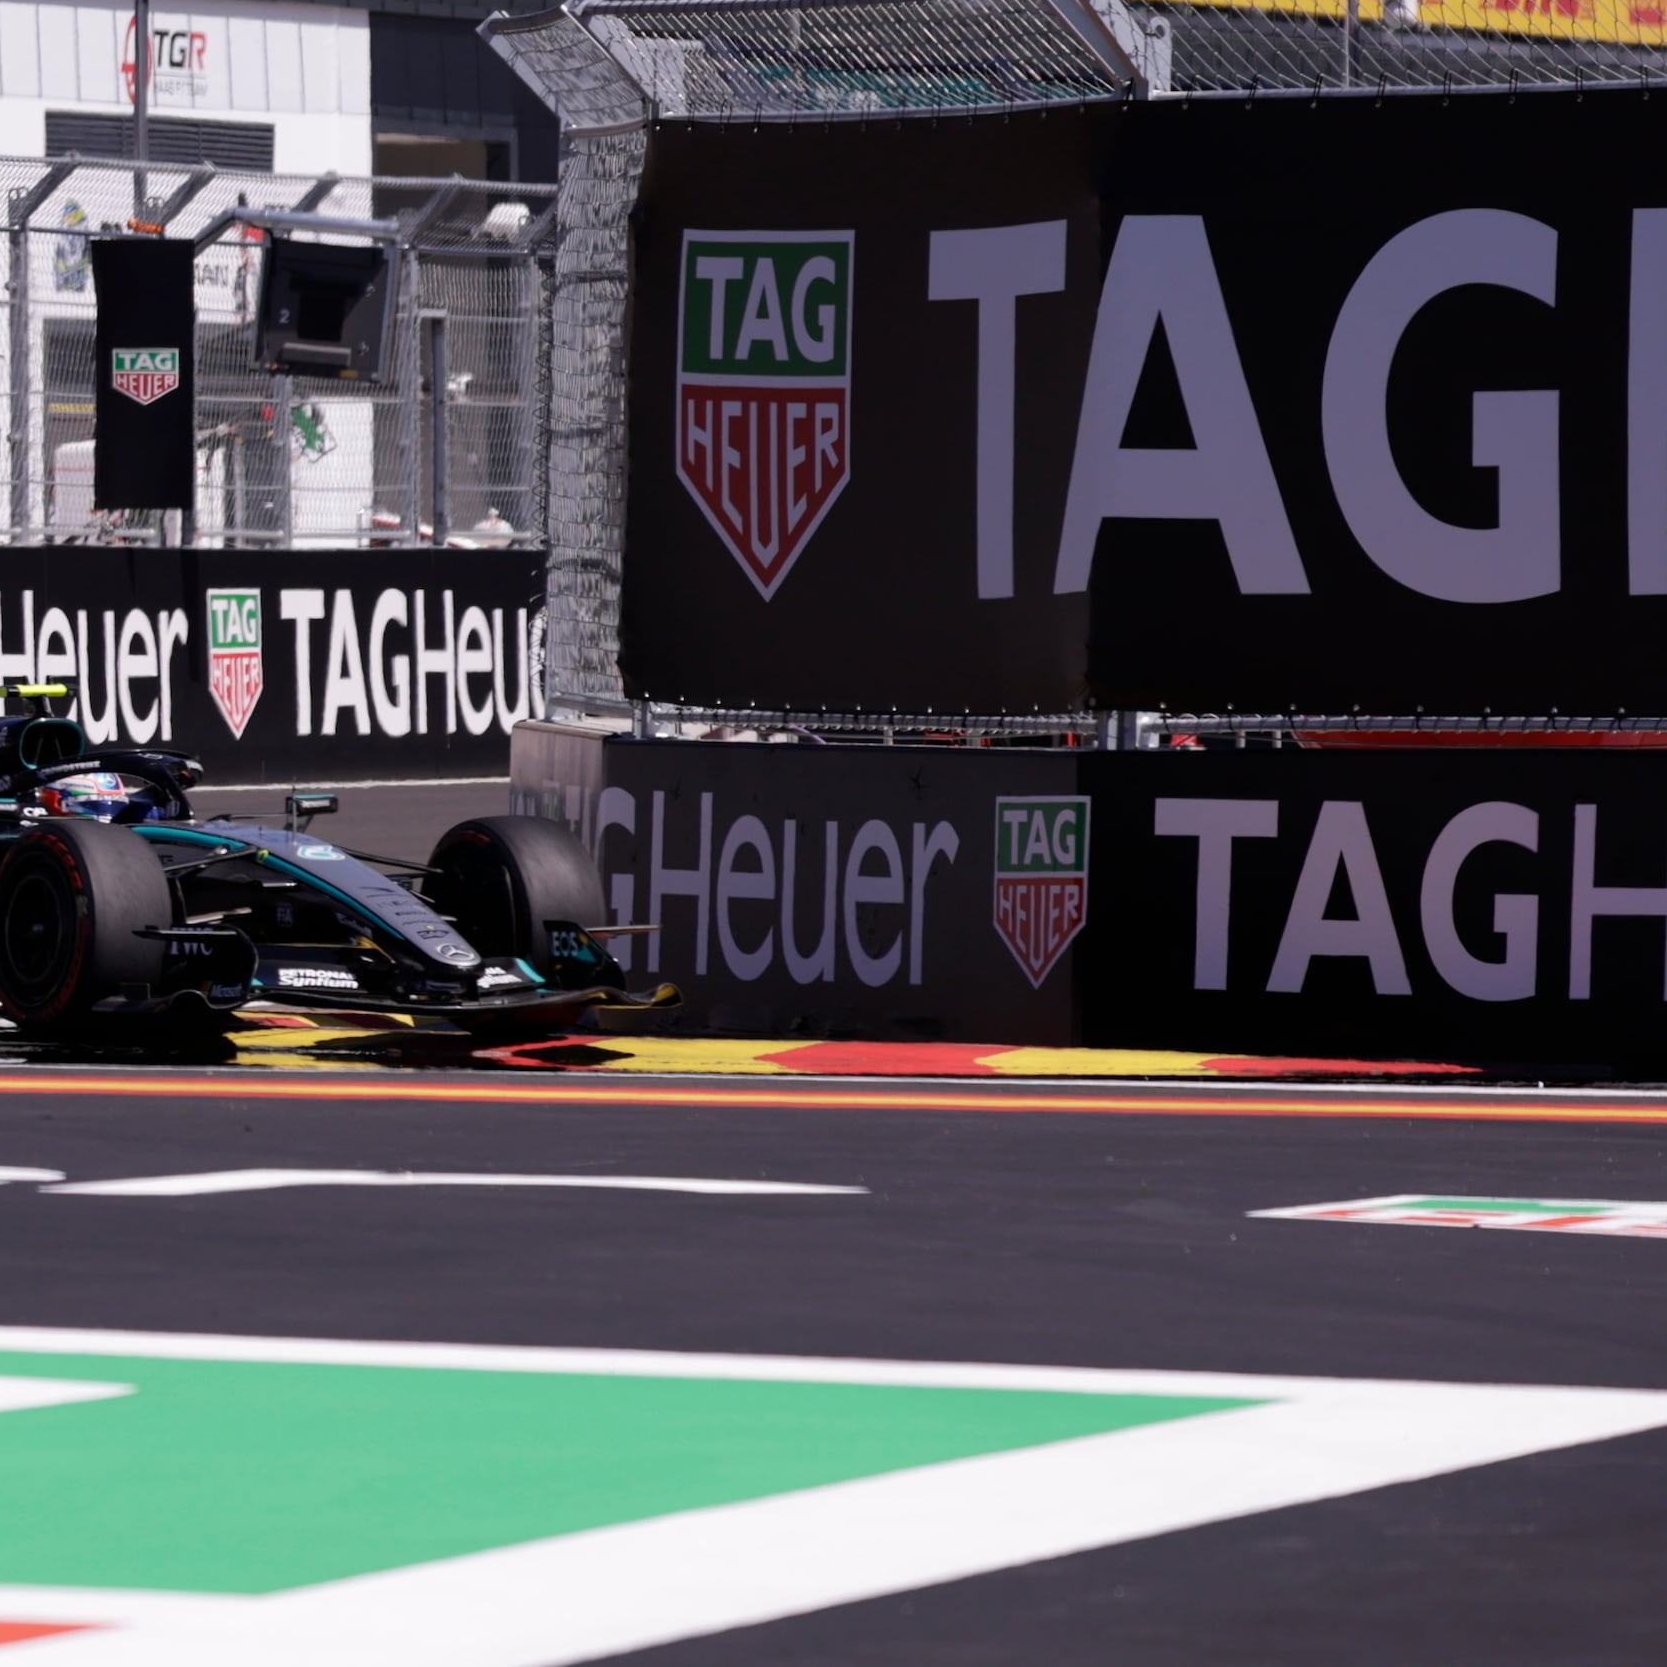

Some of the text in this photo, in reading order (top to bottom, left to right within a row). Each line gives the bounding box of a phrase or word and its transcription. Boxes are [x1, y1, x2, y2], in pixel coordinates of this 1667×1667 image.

[153, 30, 207, 71] TGR
[278, 309, 291, 324] 2
[696, 254, 837, 363] TAG
[115, 349, 174, 371] TAG
[115, 371, 177, 401] HEUER
[683, 399, 844, 567] HEUER
[210, 594, 261, 645] TAG
[280, 588, 547, 738] TAGHeu
[208, 659, 262, 734] HEUER
[1000, 807, 1079, 865] TAG
[996, 886, 1083, 975] HEUER
[278, 975, 359, 989] Syntium
